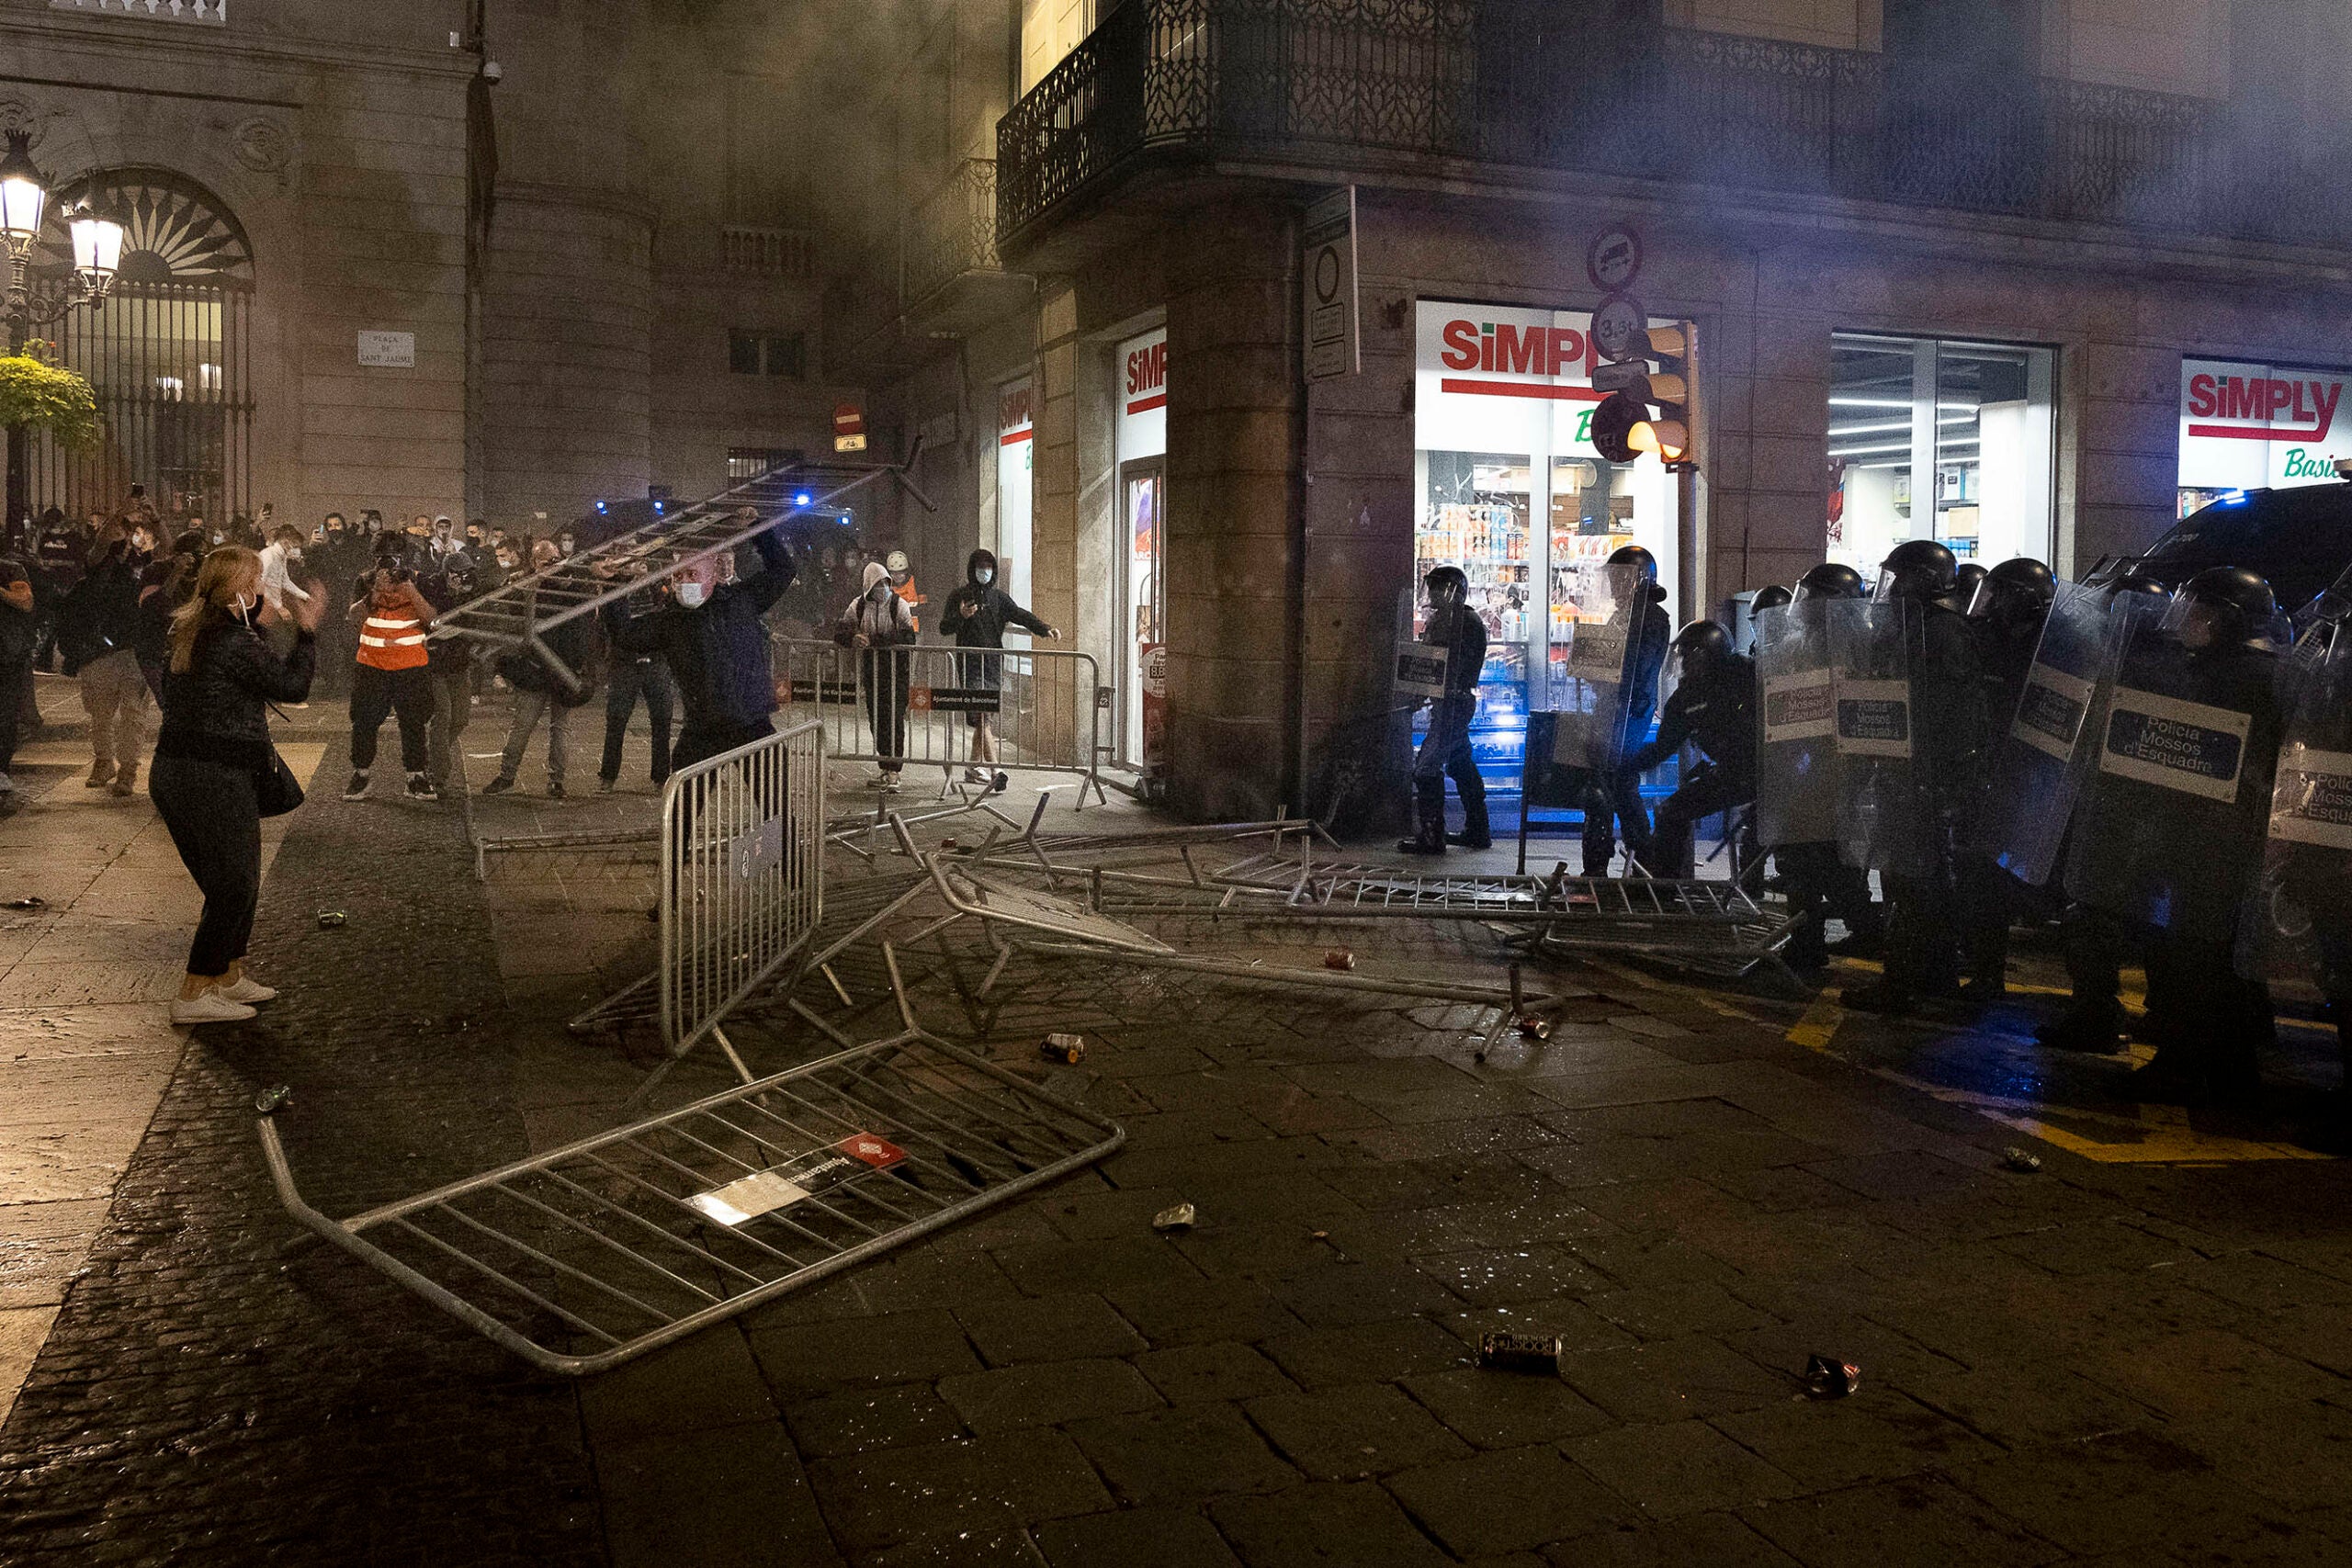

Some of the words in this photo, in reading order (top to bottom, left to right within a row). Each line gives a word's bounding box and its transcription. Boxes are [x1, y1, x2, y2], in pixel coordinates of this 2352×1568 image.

[933, 695, 963, 705] Ajuntament
[971, 696, 998, 705] Barcelona
[1788, 697, 1827, 710] Mossos
[1857, 712, 1891, 724] Mossos
[2147, 716, 2200, 740] Policia
[2141, 729, 2202, 756] Mossos
[2123, 742, 2212, 773] d'Esquadra
[786, 1156, 851, 1183] Ajuntamen
